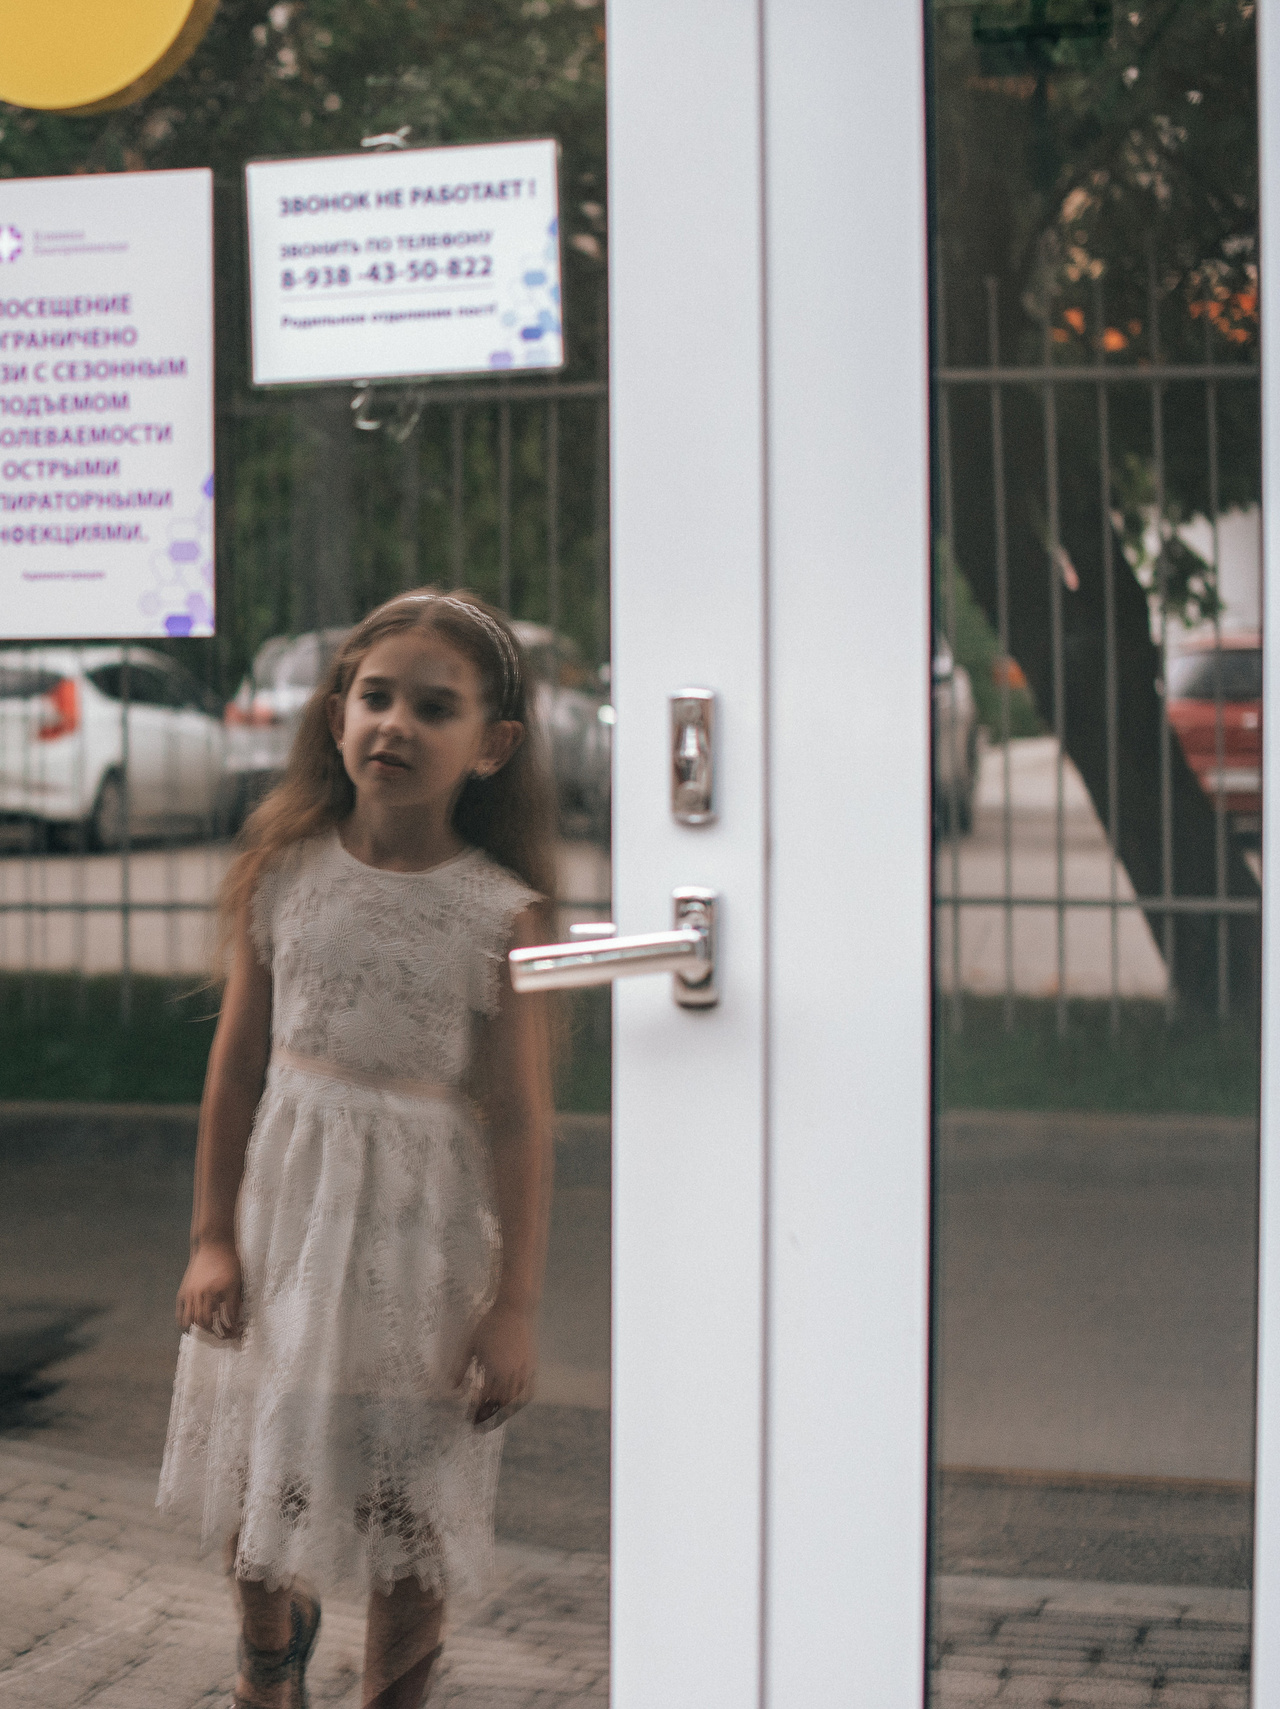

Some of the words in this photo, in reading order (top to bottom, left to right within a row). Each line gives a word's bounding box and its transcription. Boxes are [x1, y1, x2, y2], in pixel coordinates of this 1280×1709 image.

[280, 194, 368, 214] ЗВОНОК
[376, 189, 402, 207] НЕ
[411, 180, 521, 203] РАБОТАЕТ
[281, 241, 358, 257] ЗВОНИТЬ
[367, 237, 391, 252] ПО
[398, 231, 492, 248] ТЕЛЕФОНУ
[34, 362, 47, 381] С
[53, 358, 185, 380] СЕЗОННЫМ
[2, 459, 118, 479] ОСТРЫМИ
